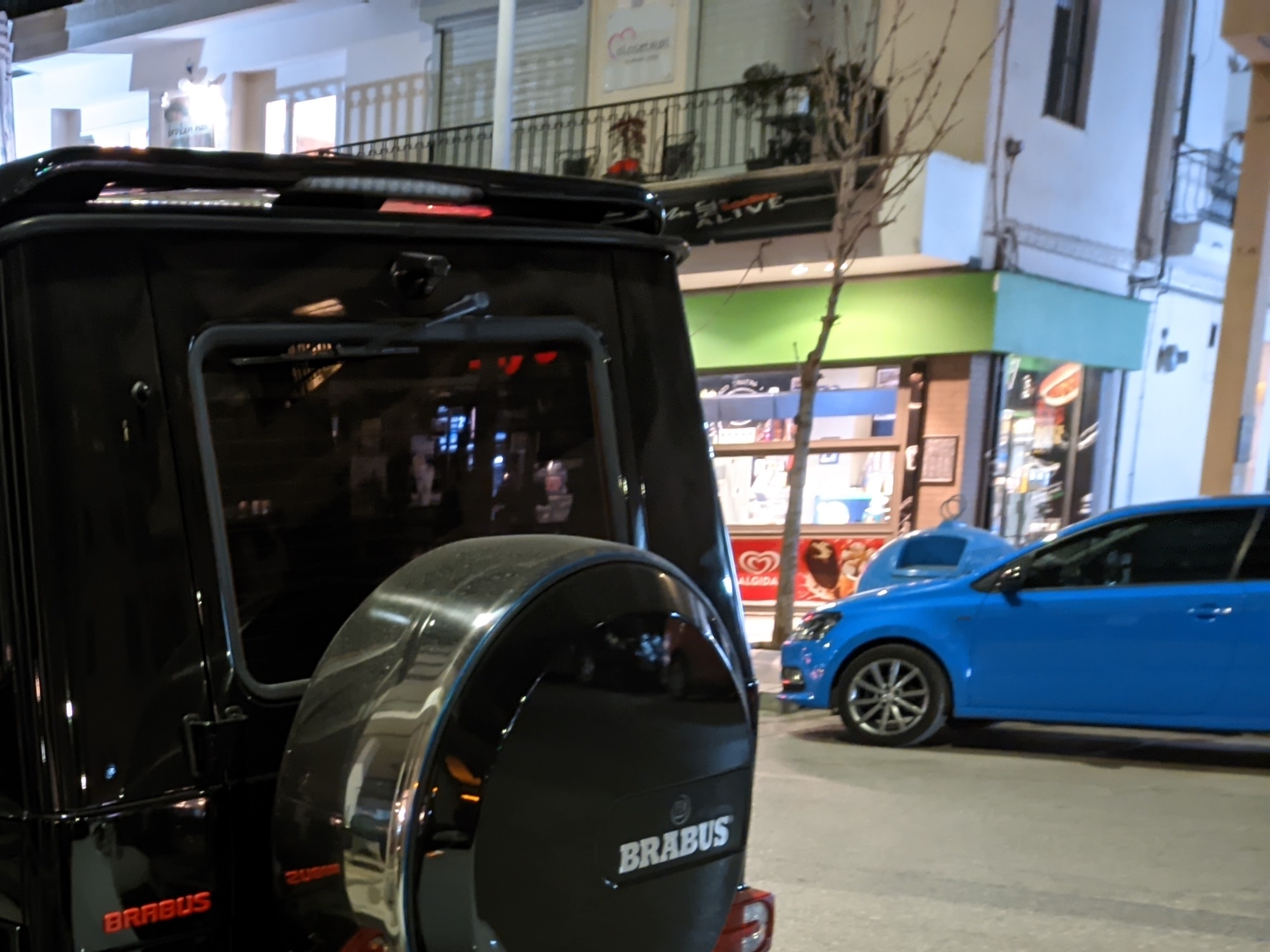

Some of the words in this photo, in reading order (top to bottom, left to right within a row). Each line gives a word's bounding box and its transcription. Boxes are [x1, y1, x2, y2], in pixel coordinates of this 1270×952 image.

[738, 575, 779, 587] ALGIDA
[618, 815, 730, 874] BRABUS
[103, 891, 211, 934] BRABUS
